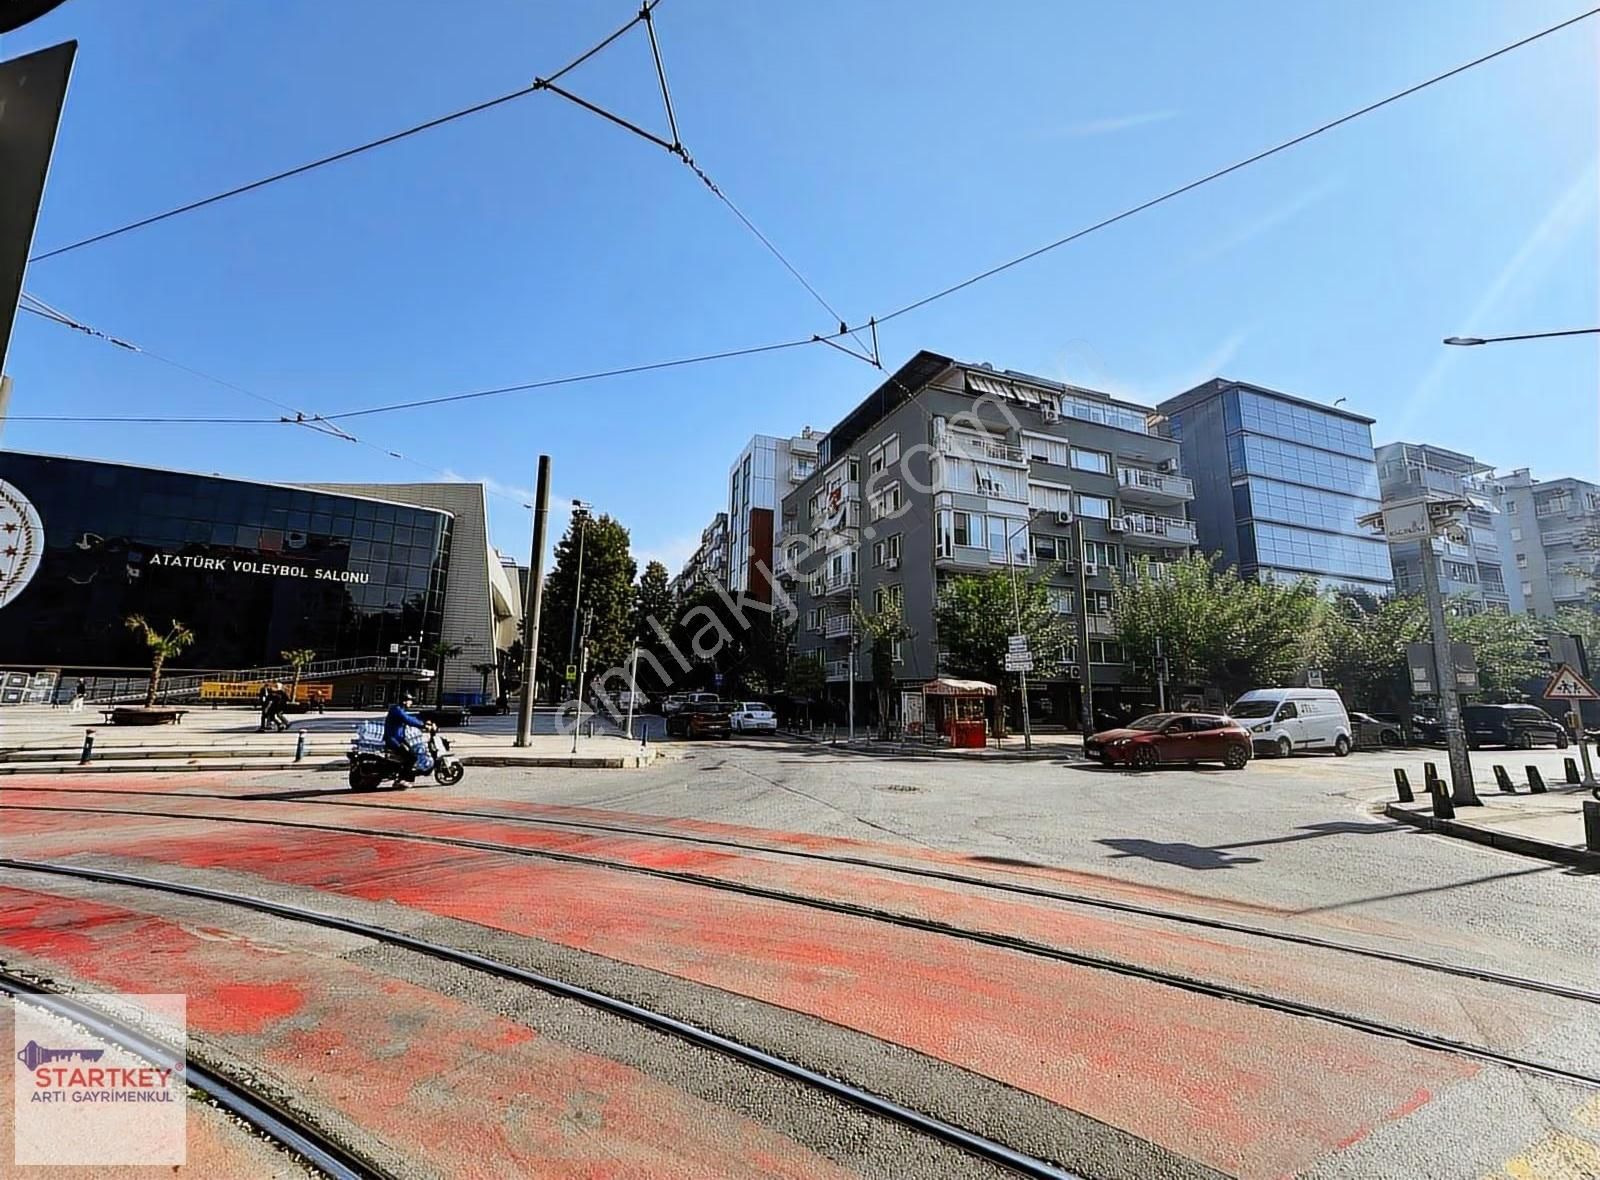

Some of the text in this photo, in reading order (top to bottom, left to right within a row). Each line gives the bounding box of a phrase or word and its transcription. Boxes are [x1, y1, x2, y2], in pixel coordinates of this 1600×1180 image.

[150, 554, 369, 584] ATATÜRK VOLEYBOL SALONU
